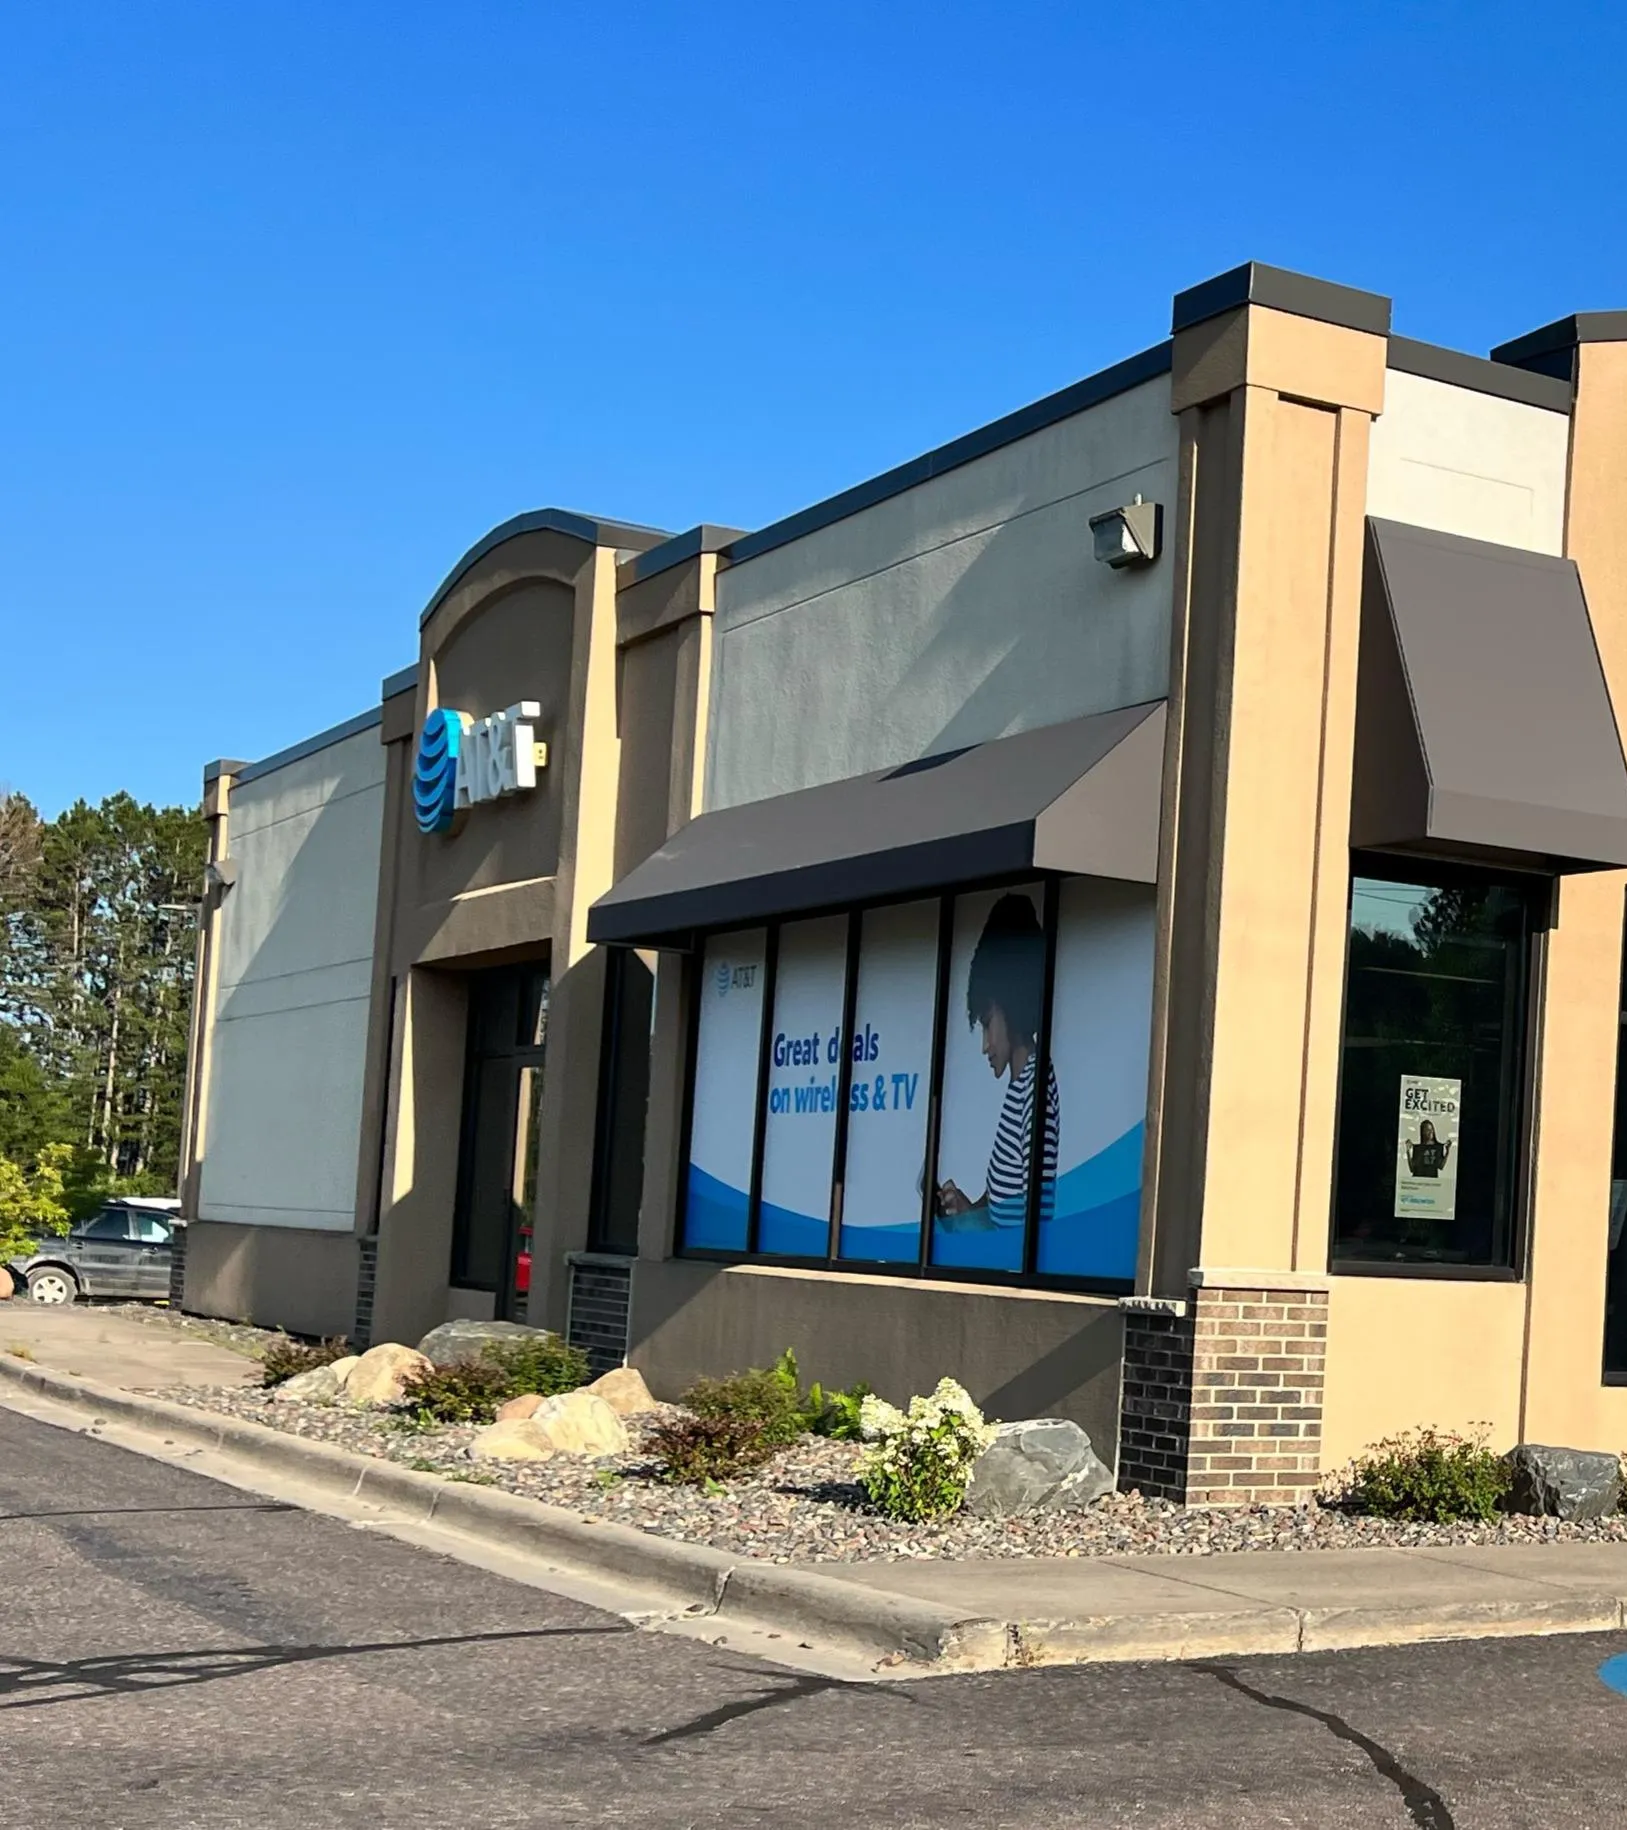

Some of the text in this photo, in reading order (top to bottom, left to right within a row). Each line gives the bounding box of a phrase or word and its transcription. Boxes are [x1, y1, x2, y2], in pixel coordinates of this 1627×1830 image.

[453, 701, 541, 809] AT&T
[731, 965, 757, 989] AT&T
[774, 1023, 879, 1067] Great dals
[770, 1073, 918, 1114] on wirelss & TV
[1405, 1088, 1429, 1100] GET
[1405, 1099, 1456, 1113] EXCITED
